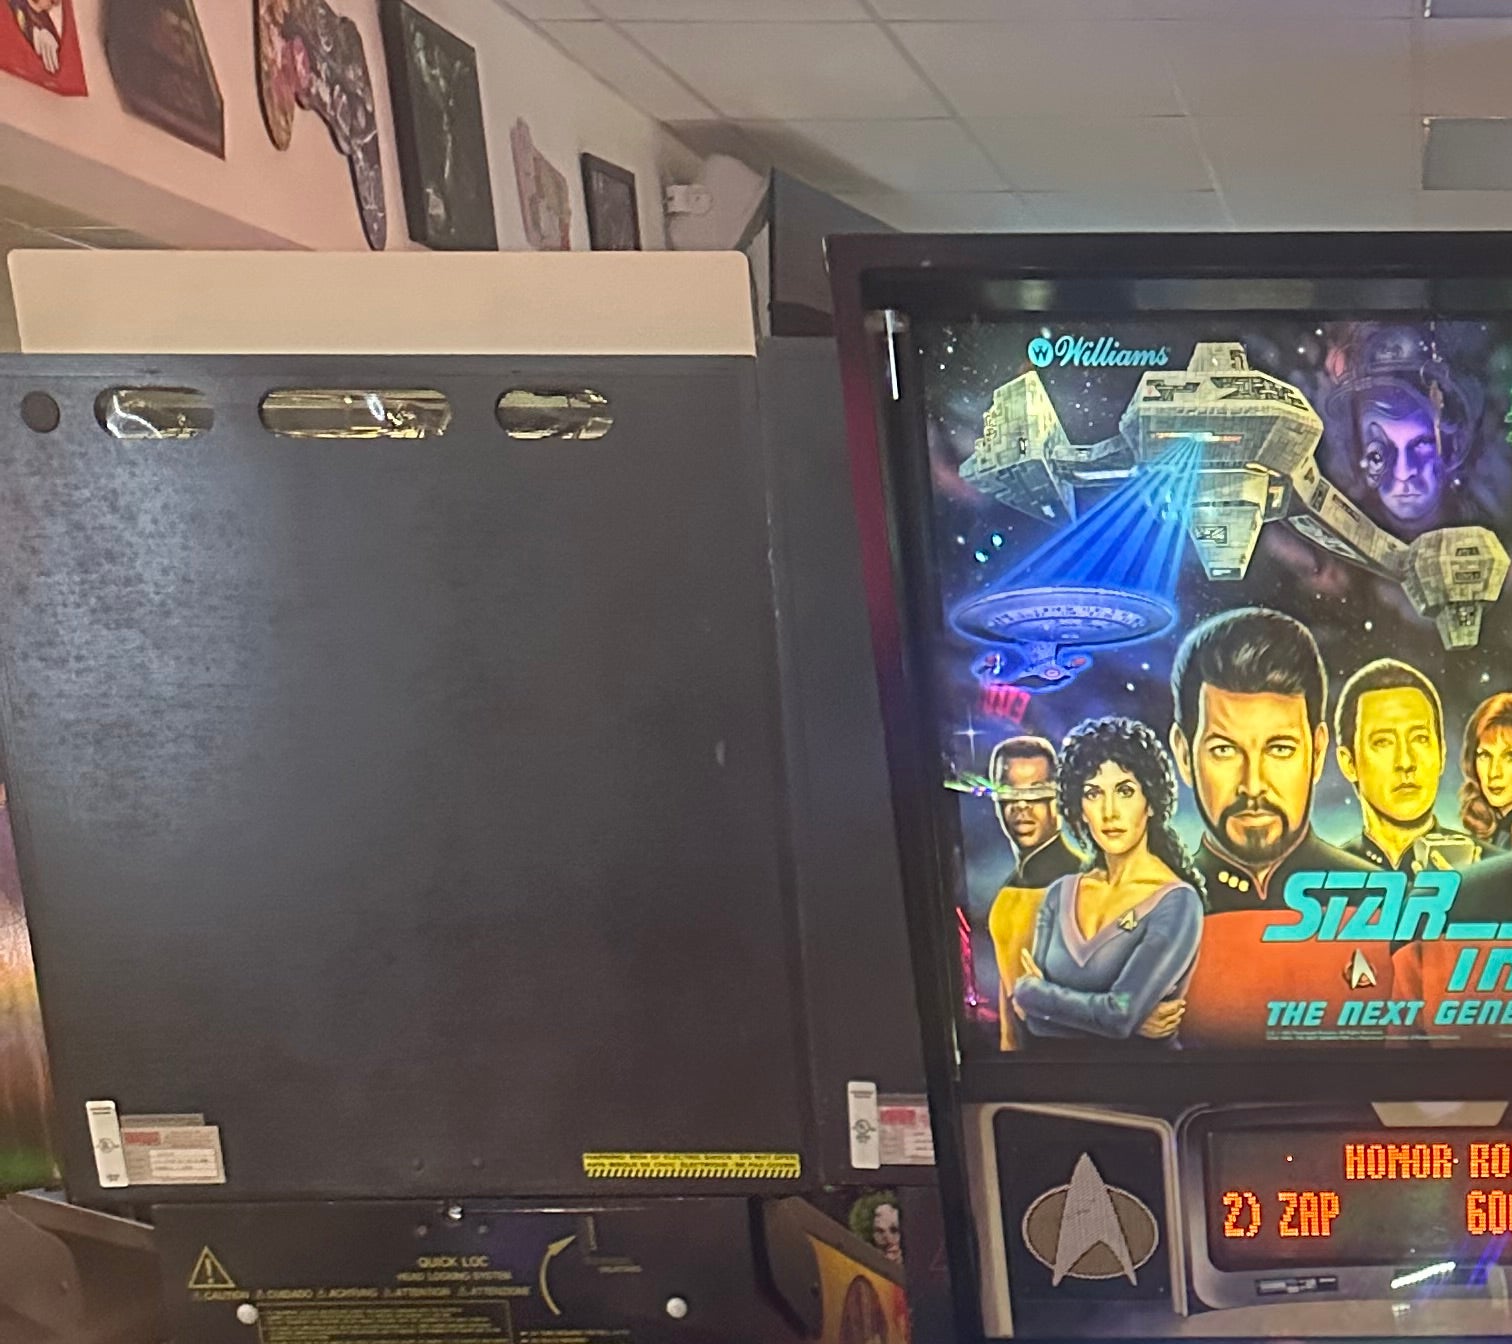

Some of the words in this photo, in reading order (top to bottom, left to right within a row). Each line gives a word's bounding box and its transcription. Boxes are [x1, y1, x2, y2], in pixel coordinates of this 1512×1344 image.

[1055, 335, 1169, 367] Williams
[1261, 870, 1462, 942] STAR
[1266, 1001, 1327, 1027] THE
[1337, 1000, 1425, 1026] NEXT
[1222, 1191, 1263, 1237] 2)
[1278, 1191, 1341, 1237] ZAP
